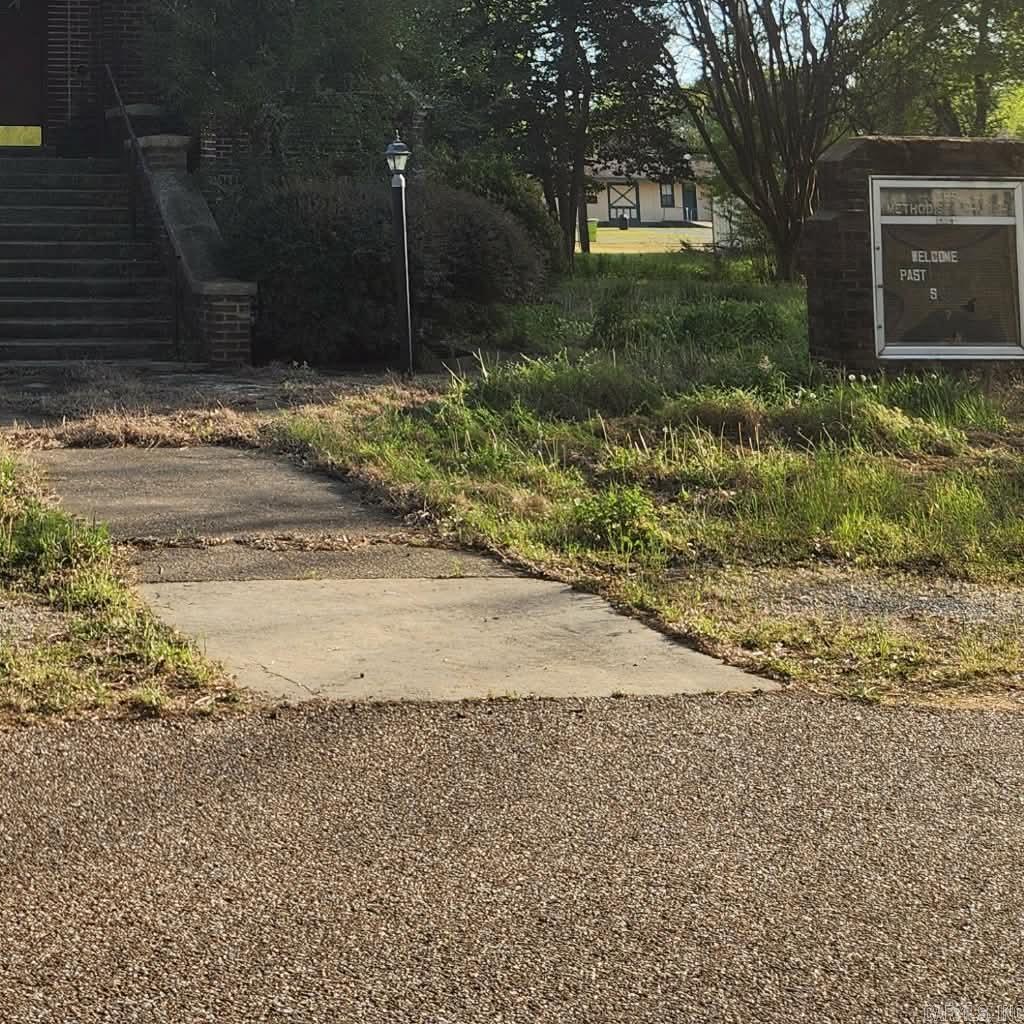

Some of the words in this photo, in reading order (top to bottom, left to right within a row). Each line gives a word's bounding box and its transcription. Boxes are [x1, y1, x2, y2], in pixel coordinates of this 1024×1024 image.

[911, 250, 959, 263] WELCOME
[899, 269, 927, 281] PAST
[929, 287, 938, 300] S
